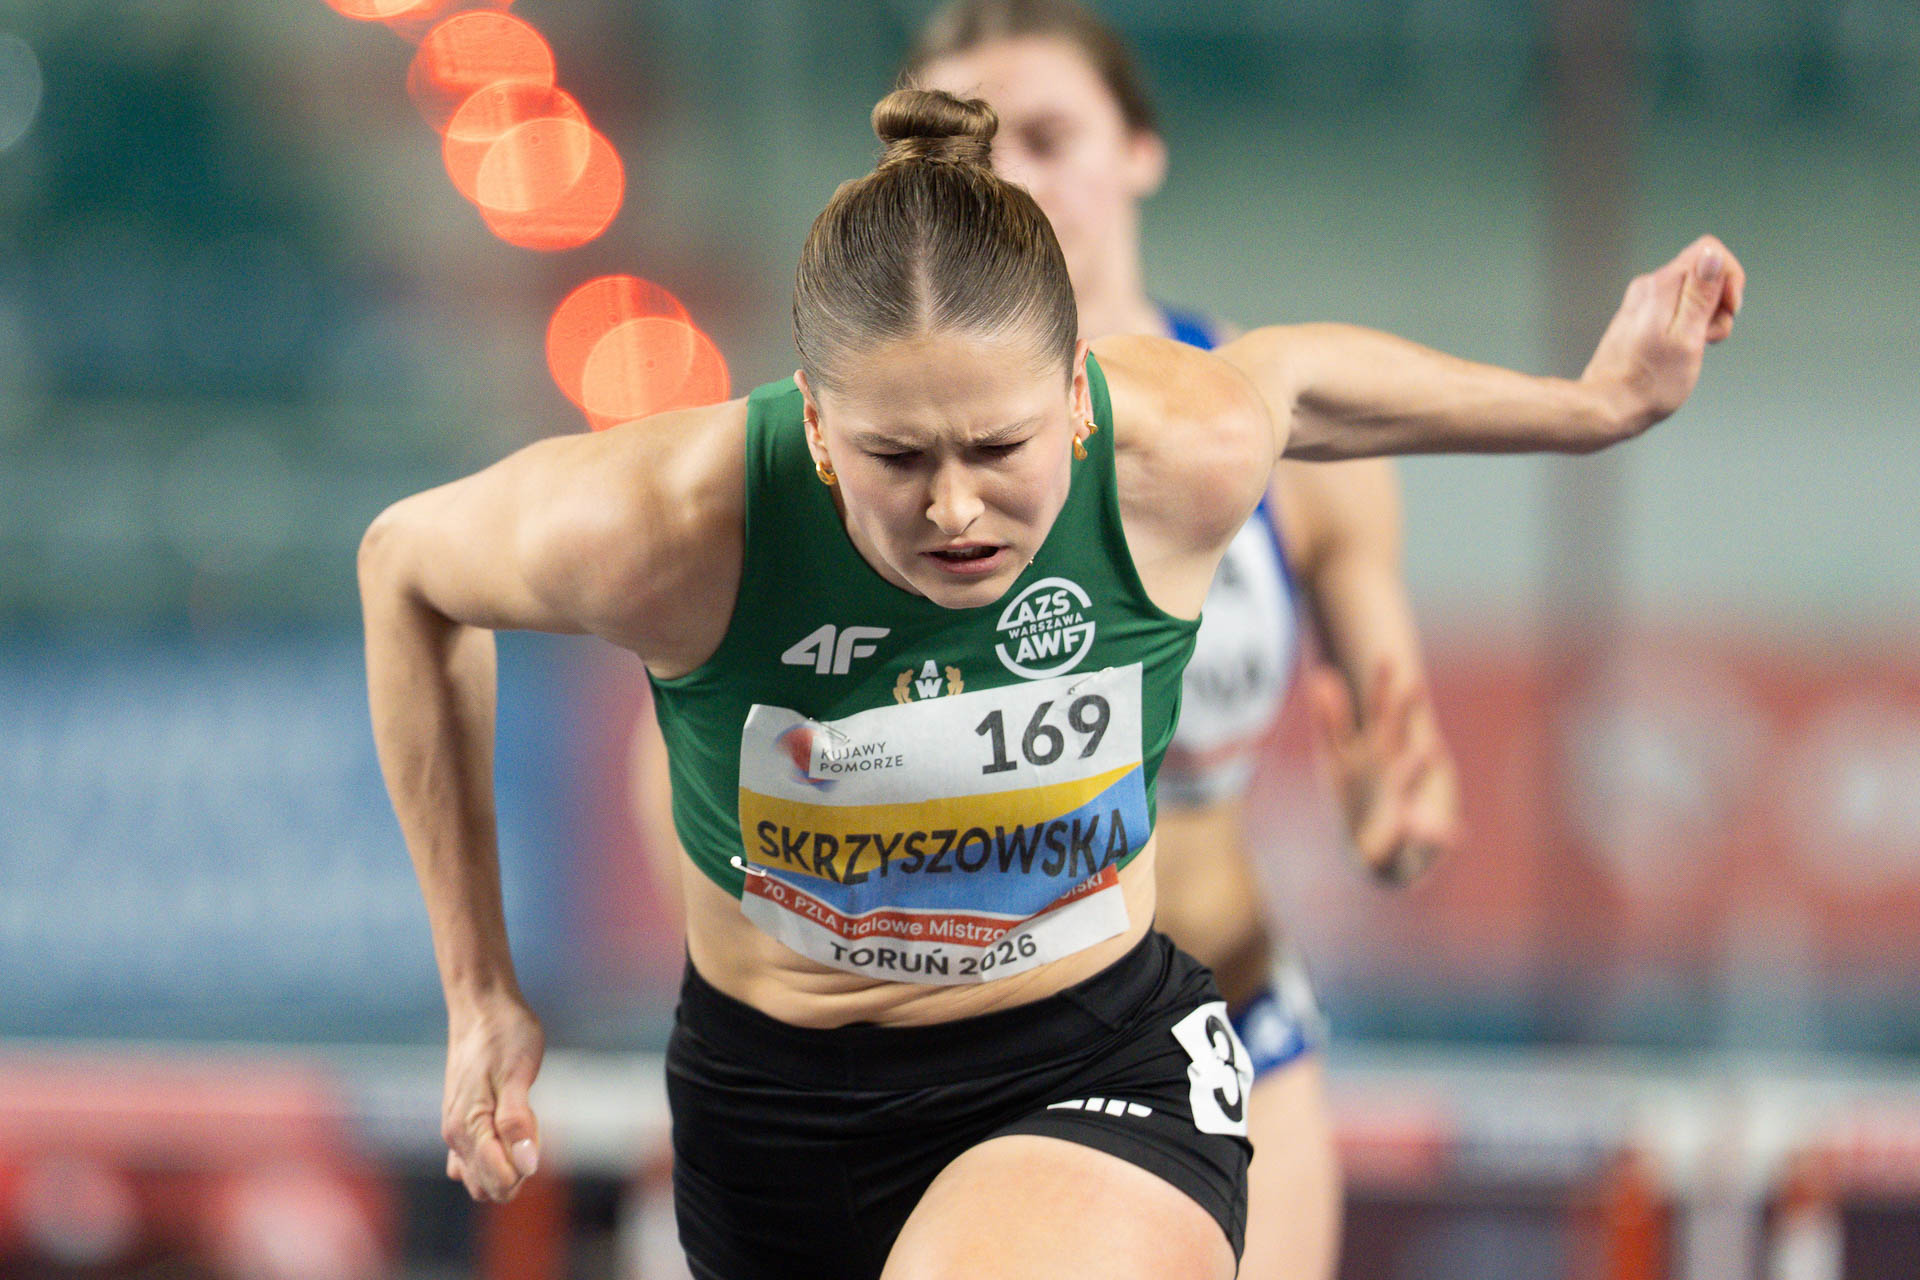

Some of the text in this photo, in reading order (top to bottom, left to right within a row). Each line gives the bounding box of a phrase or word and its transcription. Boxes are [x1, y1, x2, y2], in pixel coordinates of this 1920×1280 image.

[1008, 612, 1083, 639] WARSZAWA
[1016, 590, 1071, 623] AZS
[781, 624, 891, 674] 4F
[1015, 627, 1080, 664] AWF
[821, 742, 887, 761] KUJAWY
[975, 694, 1111, 774] 169
[820, 755, 904, 772] POMORZE
[756, 808, 1128, 885] SKRZYSZOWSKA
[794, 896, 838, 929] PZLA
[842, 917, 923, 937] Halowe
[830, 933, 1038, 976] TORUŃ 2026
[1205, 1015, 1243, 1123] 3
